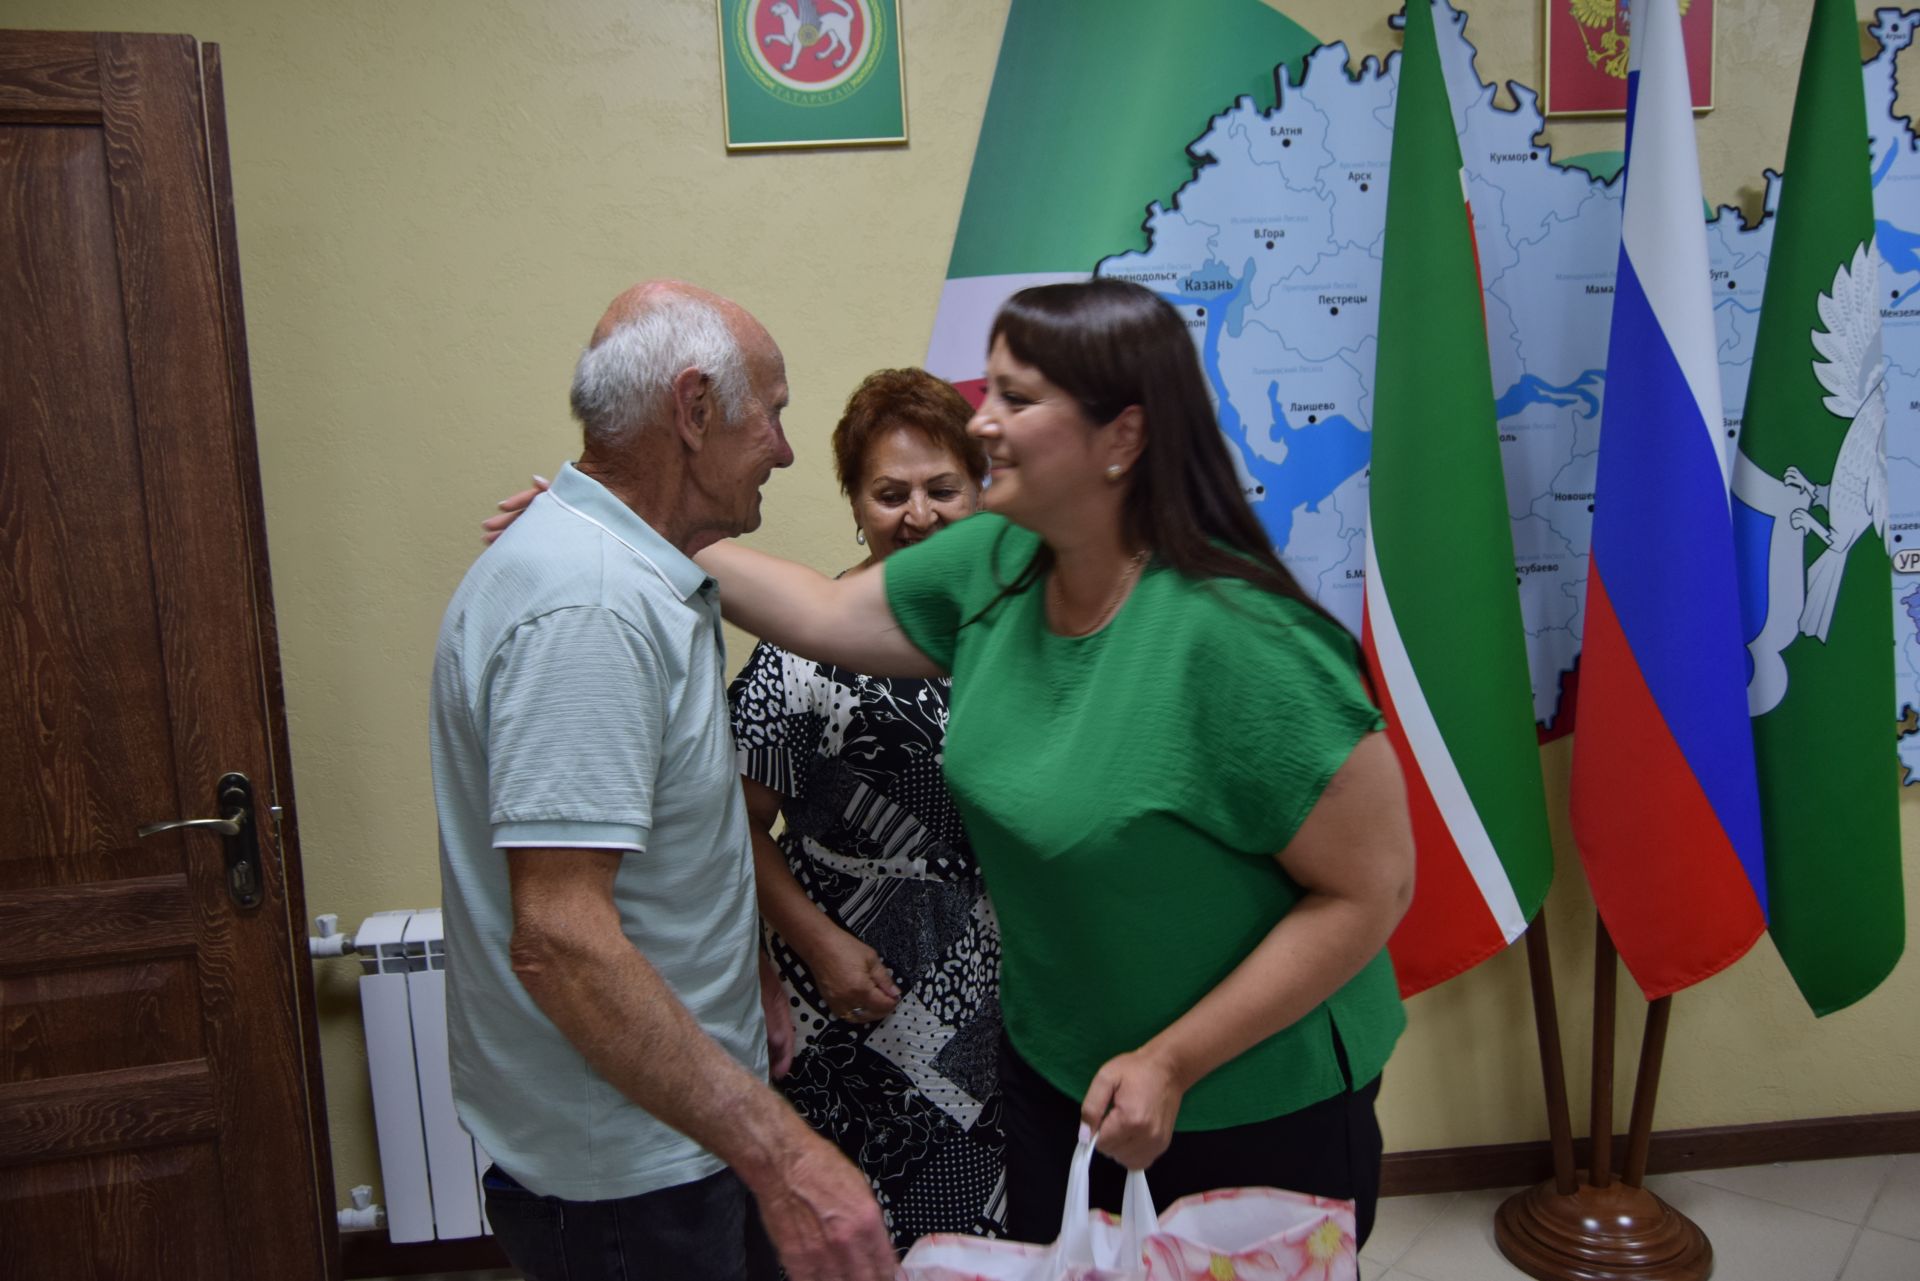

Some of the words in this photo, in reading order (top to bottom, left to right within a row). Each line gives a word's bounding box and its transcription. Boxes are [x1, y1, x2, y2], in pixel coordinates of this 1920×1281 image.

[775, 82, 853, 105] ТАТАРСТАН
[1270, 126, 1303, 137] Б.Атня
[1490, 152, 1529, 164] Кукмор
[1348, 171, 1372, 183] Арск
[1254, 228, 1286, 240] В.Гора
[1185, 279, 1234, 292] Казань
[1585, 284, 1615, 295] Мама
[1318, 294, 1368, 306] Пестрецы
[1290, 402, 1336, 412] Лаишево
